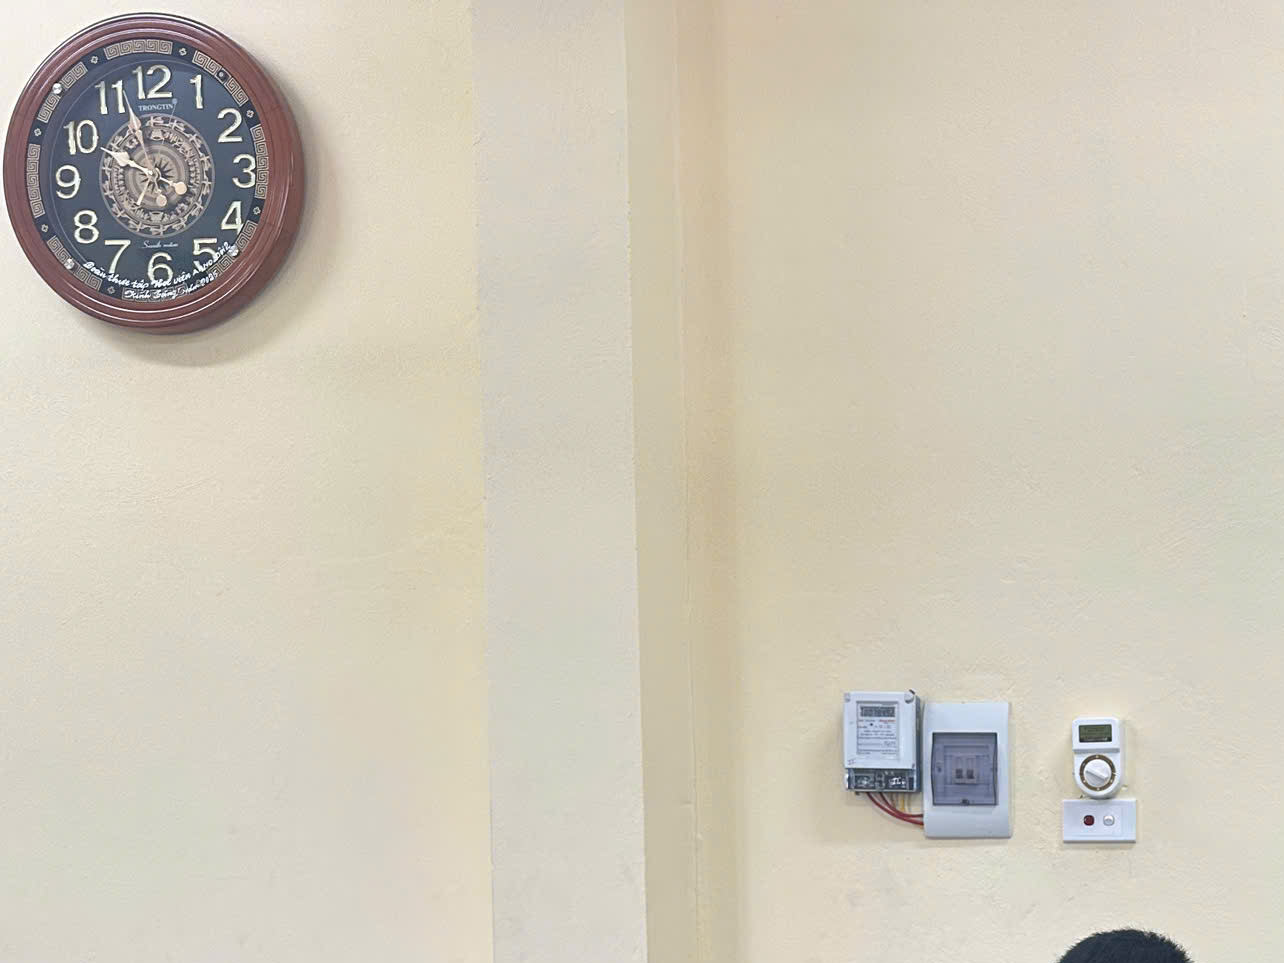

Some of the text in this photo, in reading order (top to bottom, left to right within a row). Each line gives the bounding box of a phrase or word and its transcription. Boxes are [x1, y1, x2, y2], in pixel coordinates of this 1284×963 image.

[95, 80, 125, 115] 11
[132, 64, 173, 100] 12
[190, 74, 204, 109] 1
[63, 119, 99, 155] 10
[217, 108, 243, 143] 2
[55, 164, 81, 199] 9
[232, 153, 256, 188] 3
[73, 210, 99, 244] 8
[220, 201, 244, 235] 4
[104, 239, 131, 272] 7
[147, 251, 173, 283] 6
[192, 238, 218, 272] 5
